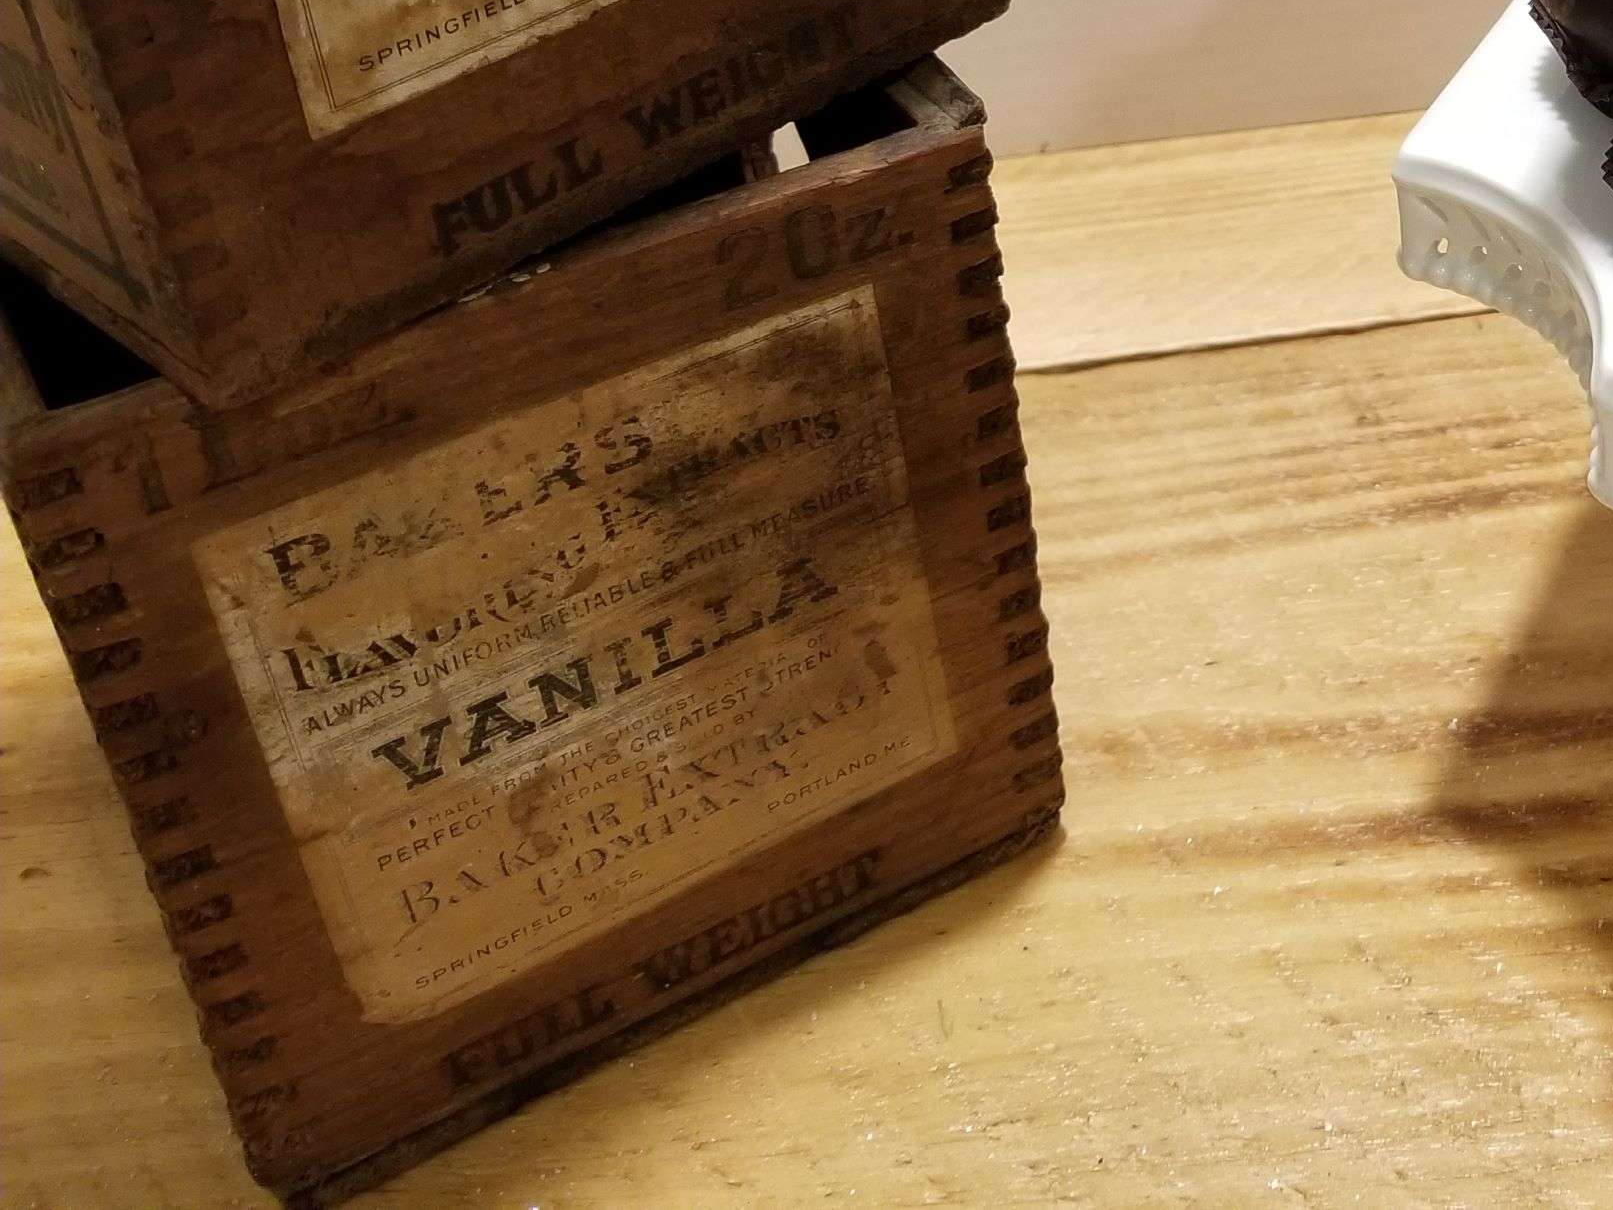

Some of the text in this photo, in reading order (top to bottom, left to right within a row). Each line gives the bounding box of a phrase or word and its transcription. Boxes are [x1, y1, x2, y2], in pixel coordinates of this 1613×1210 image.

[429, 137, 604, 261] FULL
[305, 678, 407, 736] ALWAYS
[539, 569, 653, 636] RELIABLE
[684, 532, 746, 571] FULL
[371, 556, 839, 791] VANILLA
[377, 804, 496, 873] PERFECT
[630, 688, 749, 754] GREATEST
[491, 762, 548, 796] FROM
[560, 740, 595, 766] THE
[604, 693, 698, 743] CHOICEST
[550, 759, 650, 814] REPARED
[732, 709, 756, 726] BY
[767, 753, 877, 813] PORTLAND
[415, 904, 573, 990] SPRINGFIELD
[444, 845, 882, 1088] FULL WEIGHT
